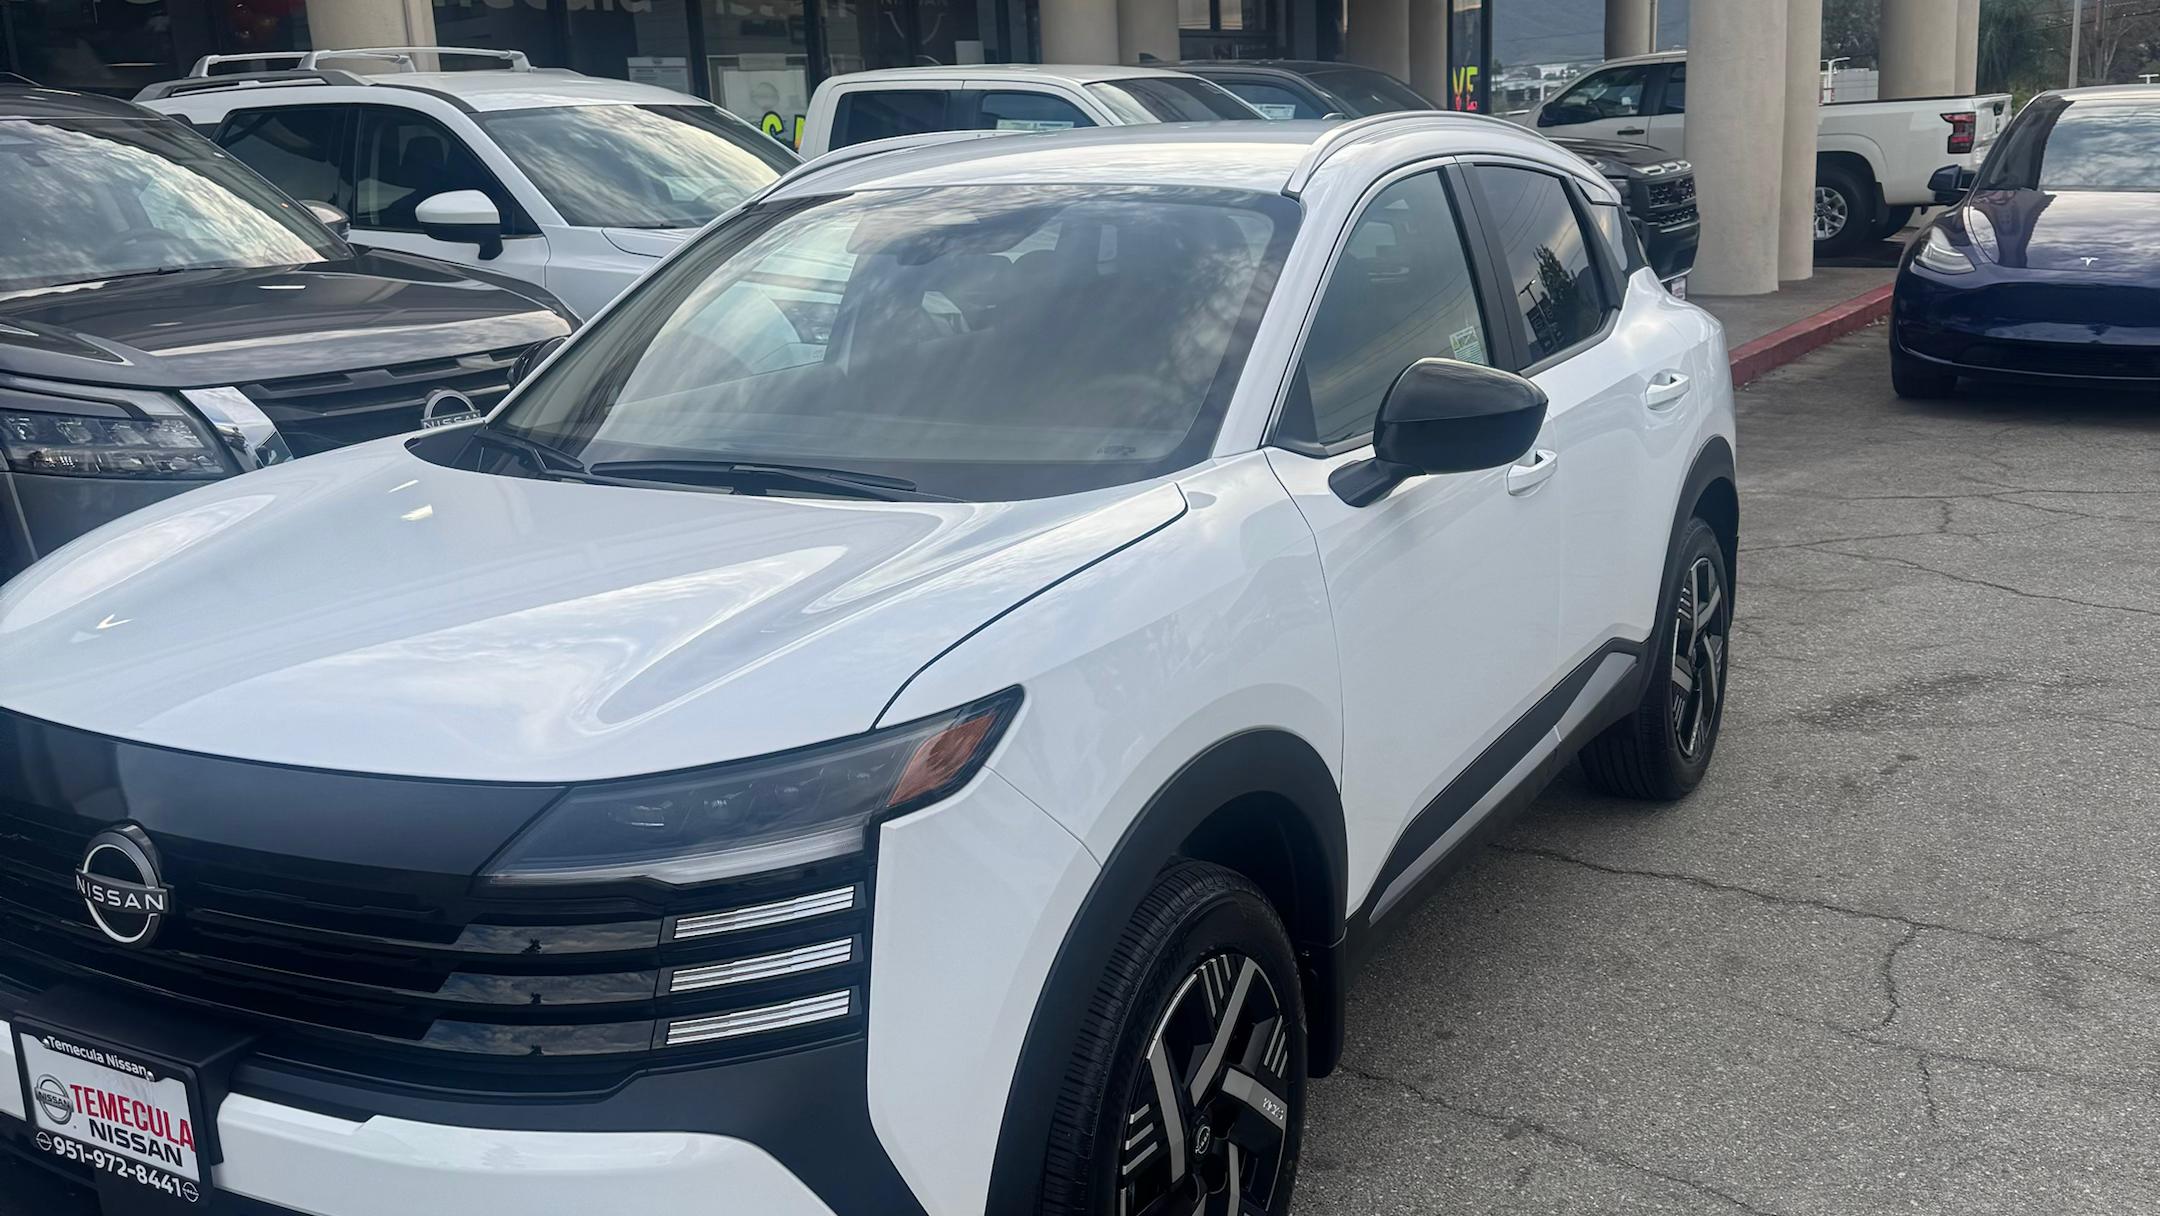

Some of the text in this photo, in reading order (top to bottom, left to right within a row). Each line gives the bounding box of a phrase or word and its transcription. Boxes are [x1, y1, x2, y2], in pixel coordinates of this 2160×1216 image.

[75, 874, 164, 911] NISSAN
[46, 1035, 148, 1077] Temecula Nissan
[69, 1084, 196, 1153] TEMECULA
[89, 1118, 184, 1168] NISSAN
[52, 1135, 182, 1198] 951-972-8441
